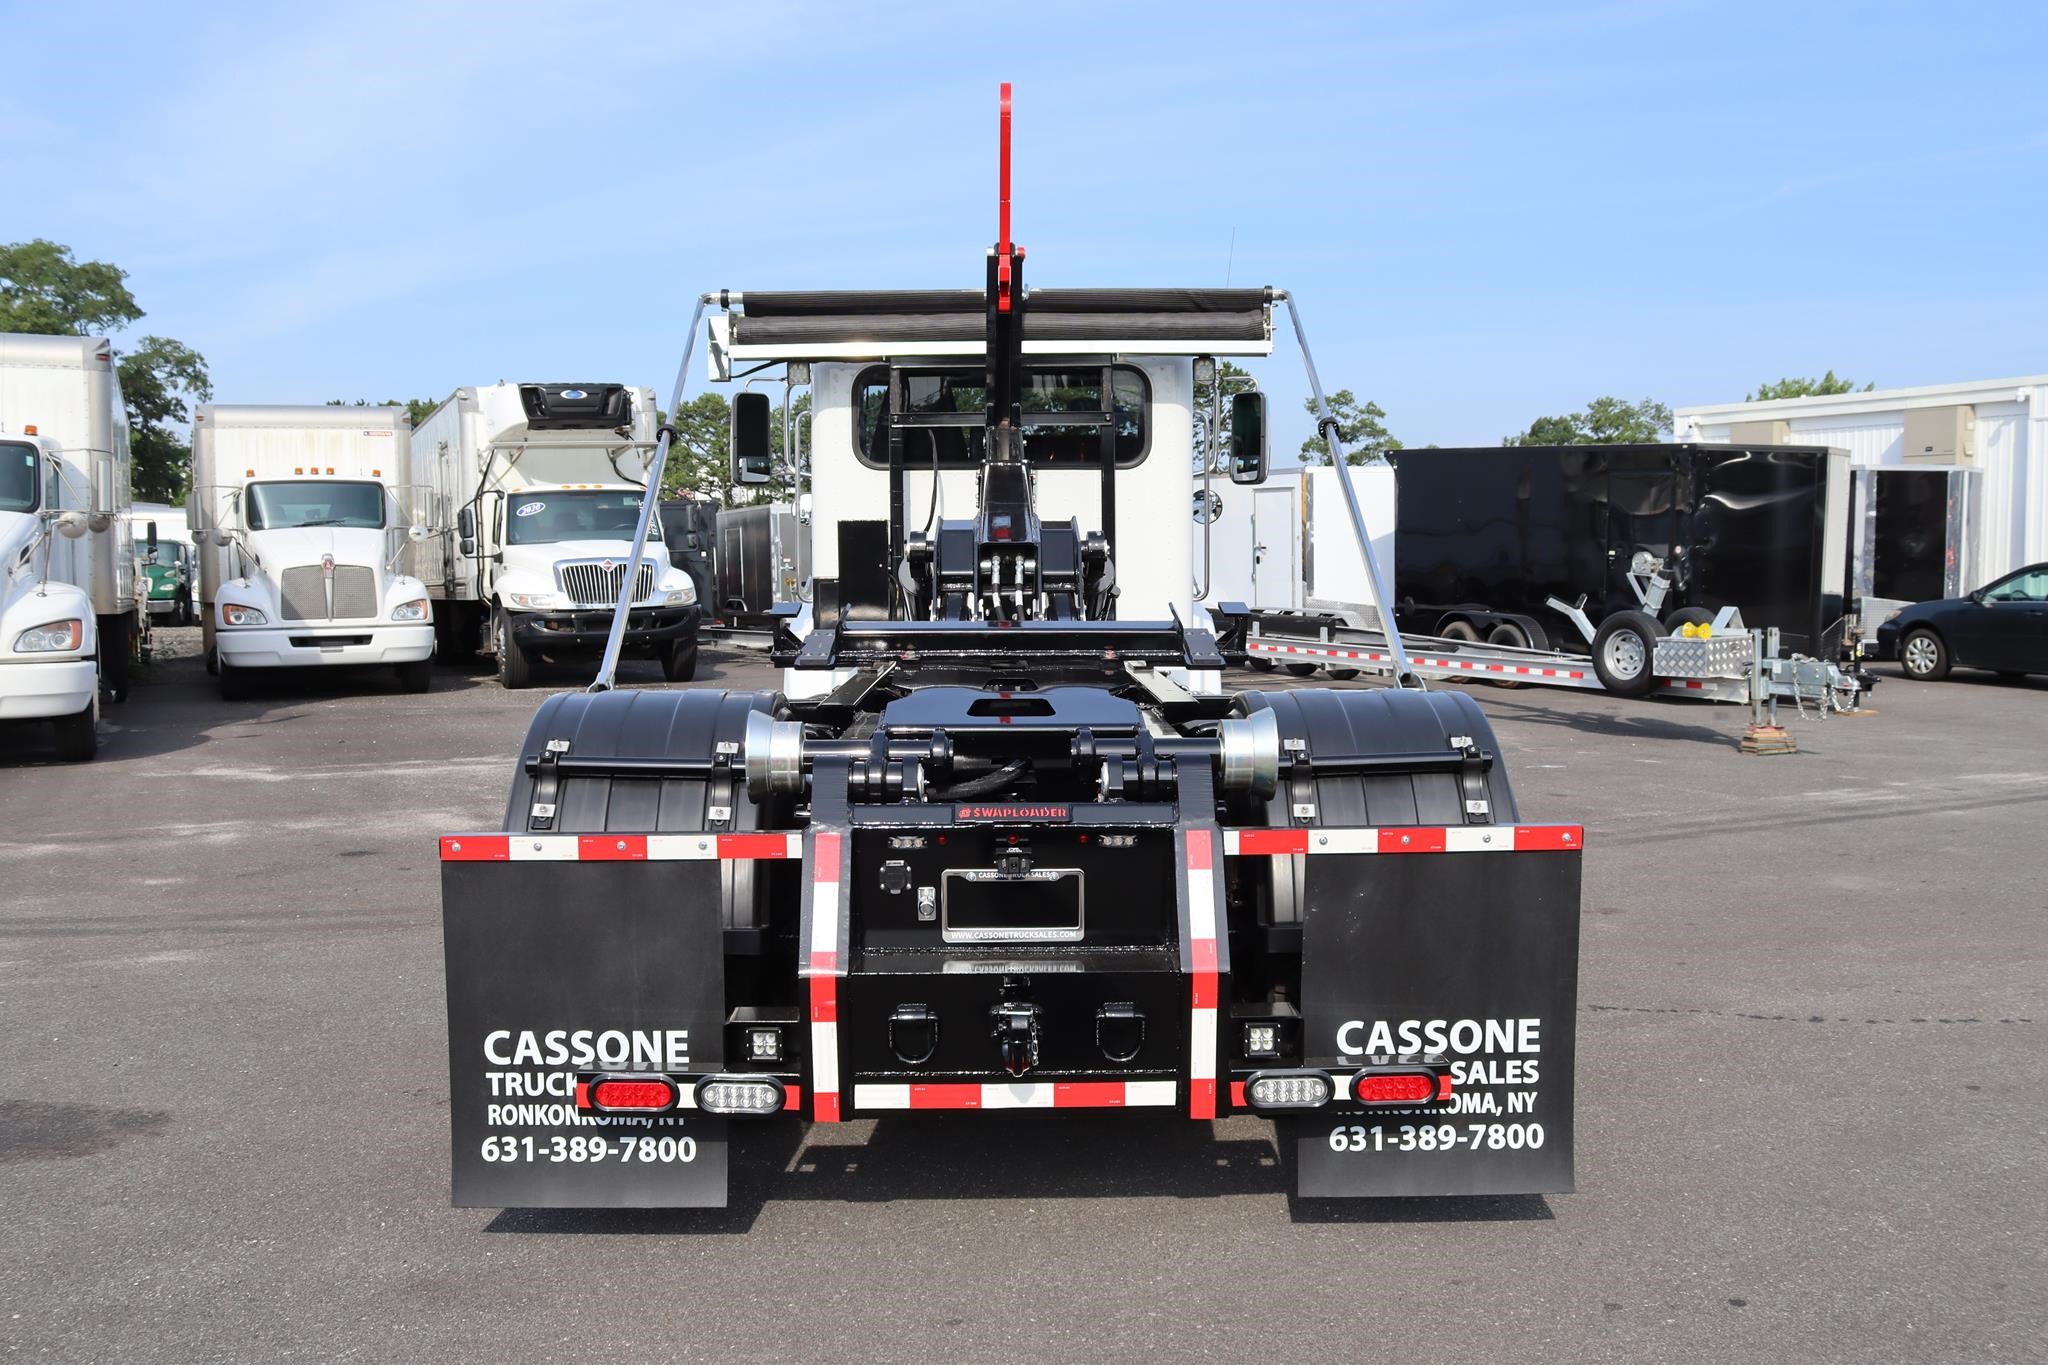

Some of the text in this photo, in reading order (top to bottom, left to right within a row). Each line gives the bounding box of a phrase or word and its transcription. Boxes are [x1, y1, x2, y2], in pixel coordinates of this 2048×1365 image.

[973, 807, 1066, 818] SWAPLOADER
[951, 931, 1077, 940] WWW.CASSONETRUCKSALES.COM
[484, 1030, 690, 1066] CASSONE
[1336, 1018, 1541, 1055] CASSONE
[1450, 1060, 1540, 1085] SALES
[1507, 1092, 1538, 1113] NY
[481, 1136, 697, 1163] 631-389-7800
[1329, 1123, 1545, 1152] 631-389-7800
